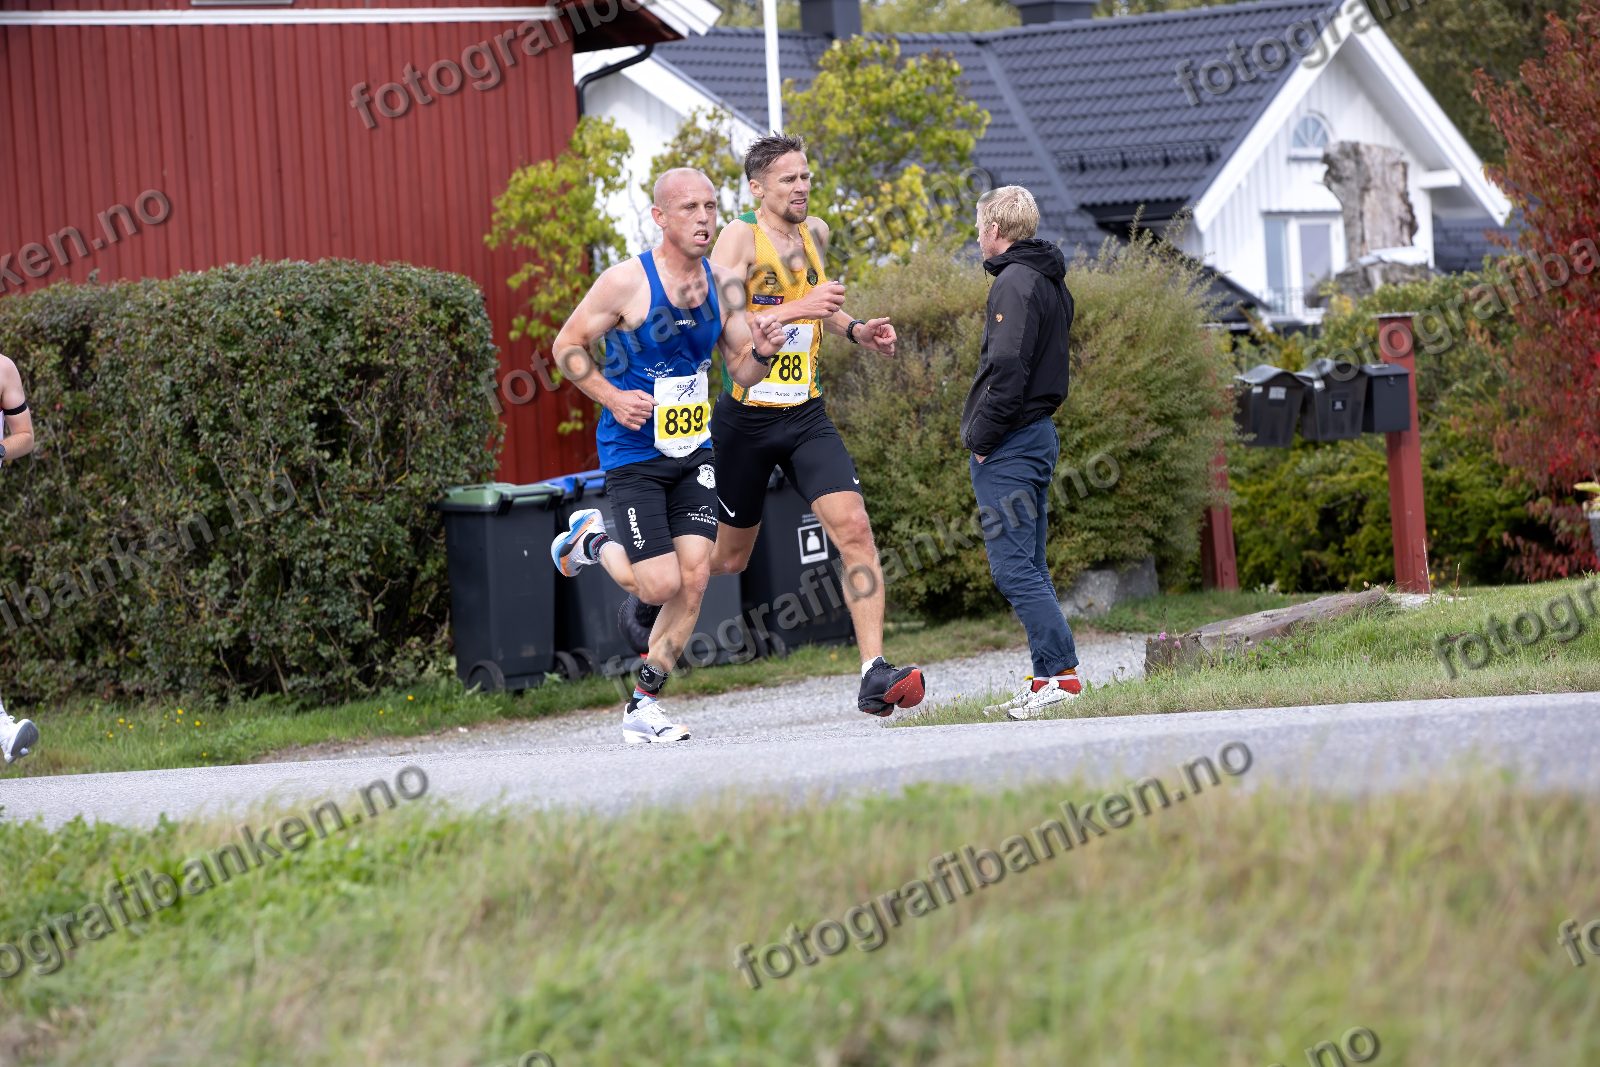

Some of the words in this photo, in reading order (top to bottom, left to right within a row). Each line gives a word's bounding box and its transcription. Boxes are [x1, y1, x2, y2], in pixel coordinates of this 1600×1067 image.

[765, 354, 803, 381] 788
[665, 405, 704, 435] 839
[627, 507, 642, 541] CRAFT
